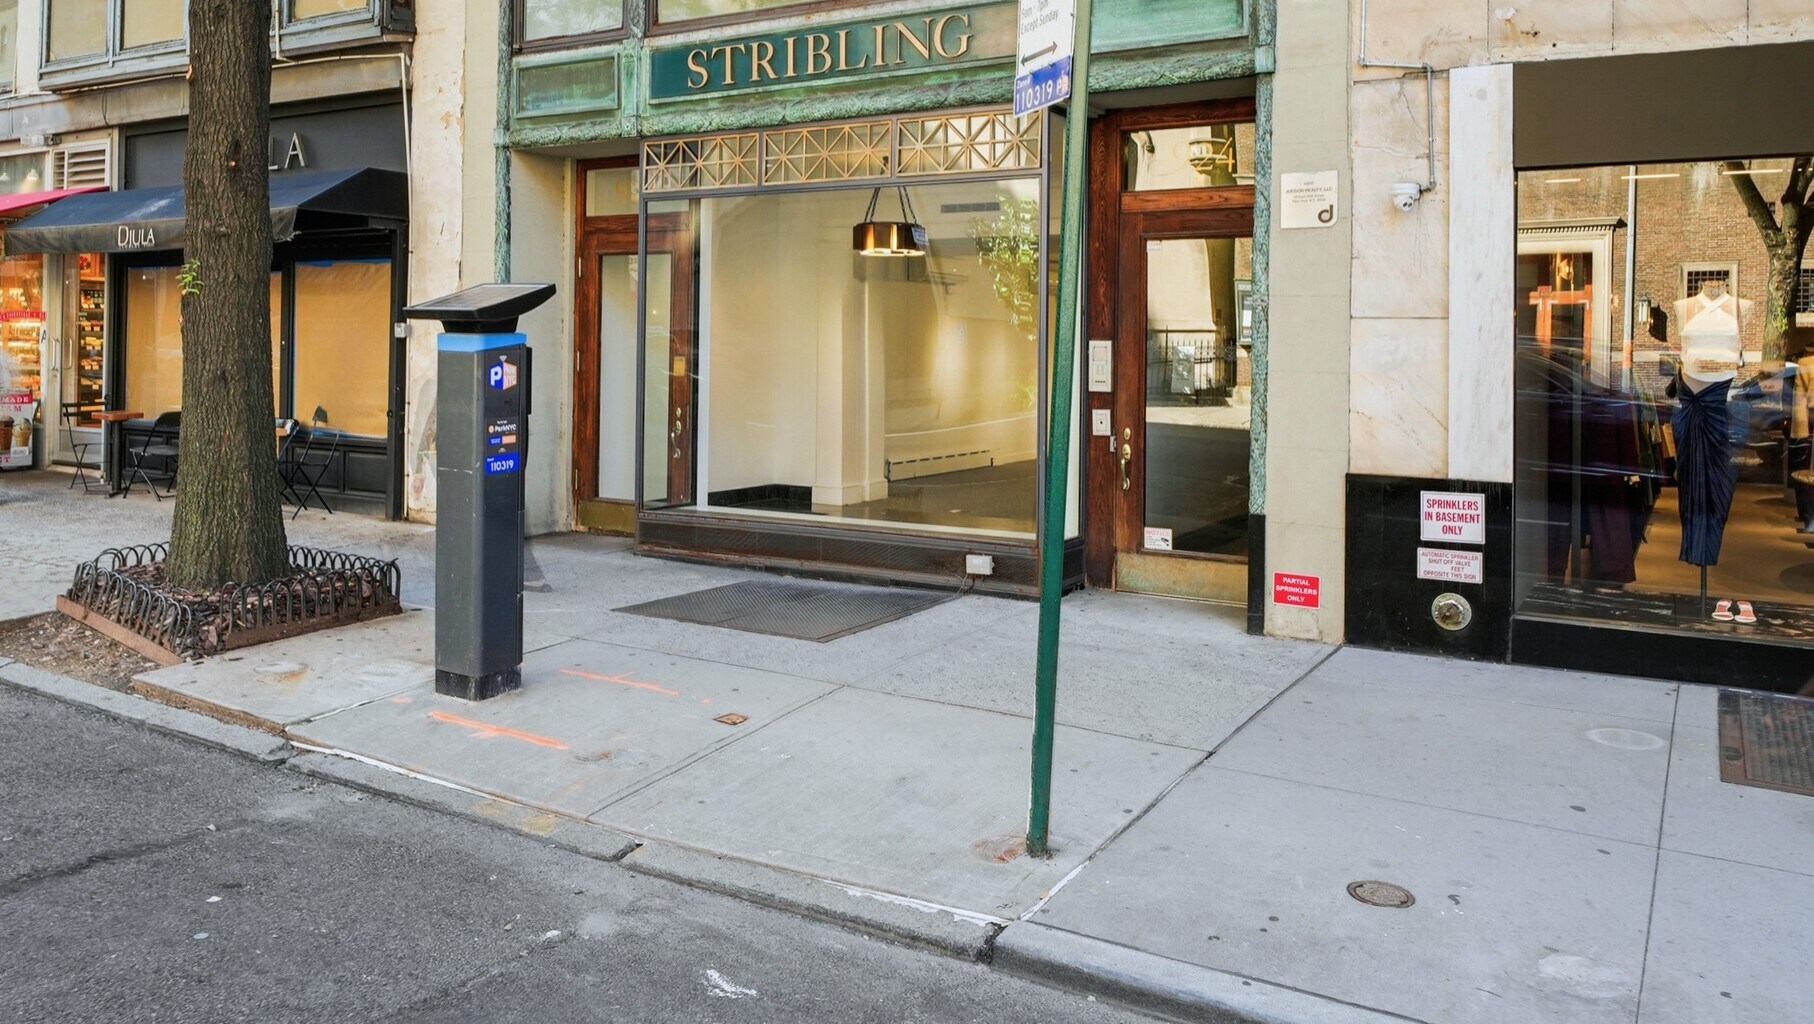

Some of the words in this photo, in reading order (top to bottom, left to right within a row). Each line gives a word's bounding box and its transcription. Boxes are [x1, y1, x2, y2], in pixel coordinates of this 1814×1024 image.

[1020, 18, 1039, 35] Except
[1040, 9, 1059, 27] Sunday
[687, 14, 973, 89] STRIBLING
[1016, 80, 1054, 113] 110319
[490, 365, 502, 386] P
[1, 396, 29, 404] MADE
[495, 424, 517, 432] ParkNYC
[490, 459, 514, 472] 110319
[1426, 498, 1479, 511] SPRINKLERS
[1424, 511, 1433, 521] IN
[1435, 511, 1480, 524] BASEMENT
[1442, 524, 1463, 535] ONLY
[1421, 551, 1449, 559] AUTOMATIC
[1450, 553, 1479, 561] SPRINKLER
[1423, 569, 1450, 577] OPPOSITE
[1282, 577, 1311, 586] PARTIAL
[1275, 585, 1318, 596] SPRINKLERS
[1287, 594, 1305, 603] ONLY
